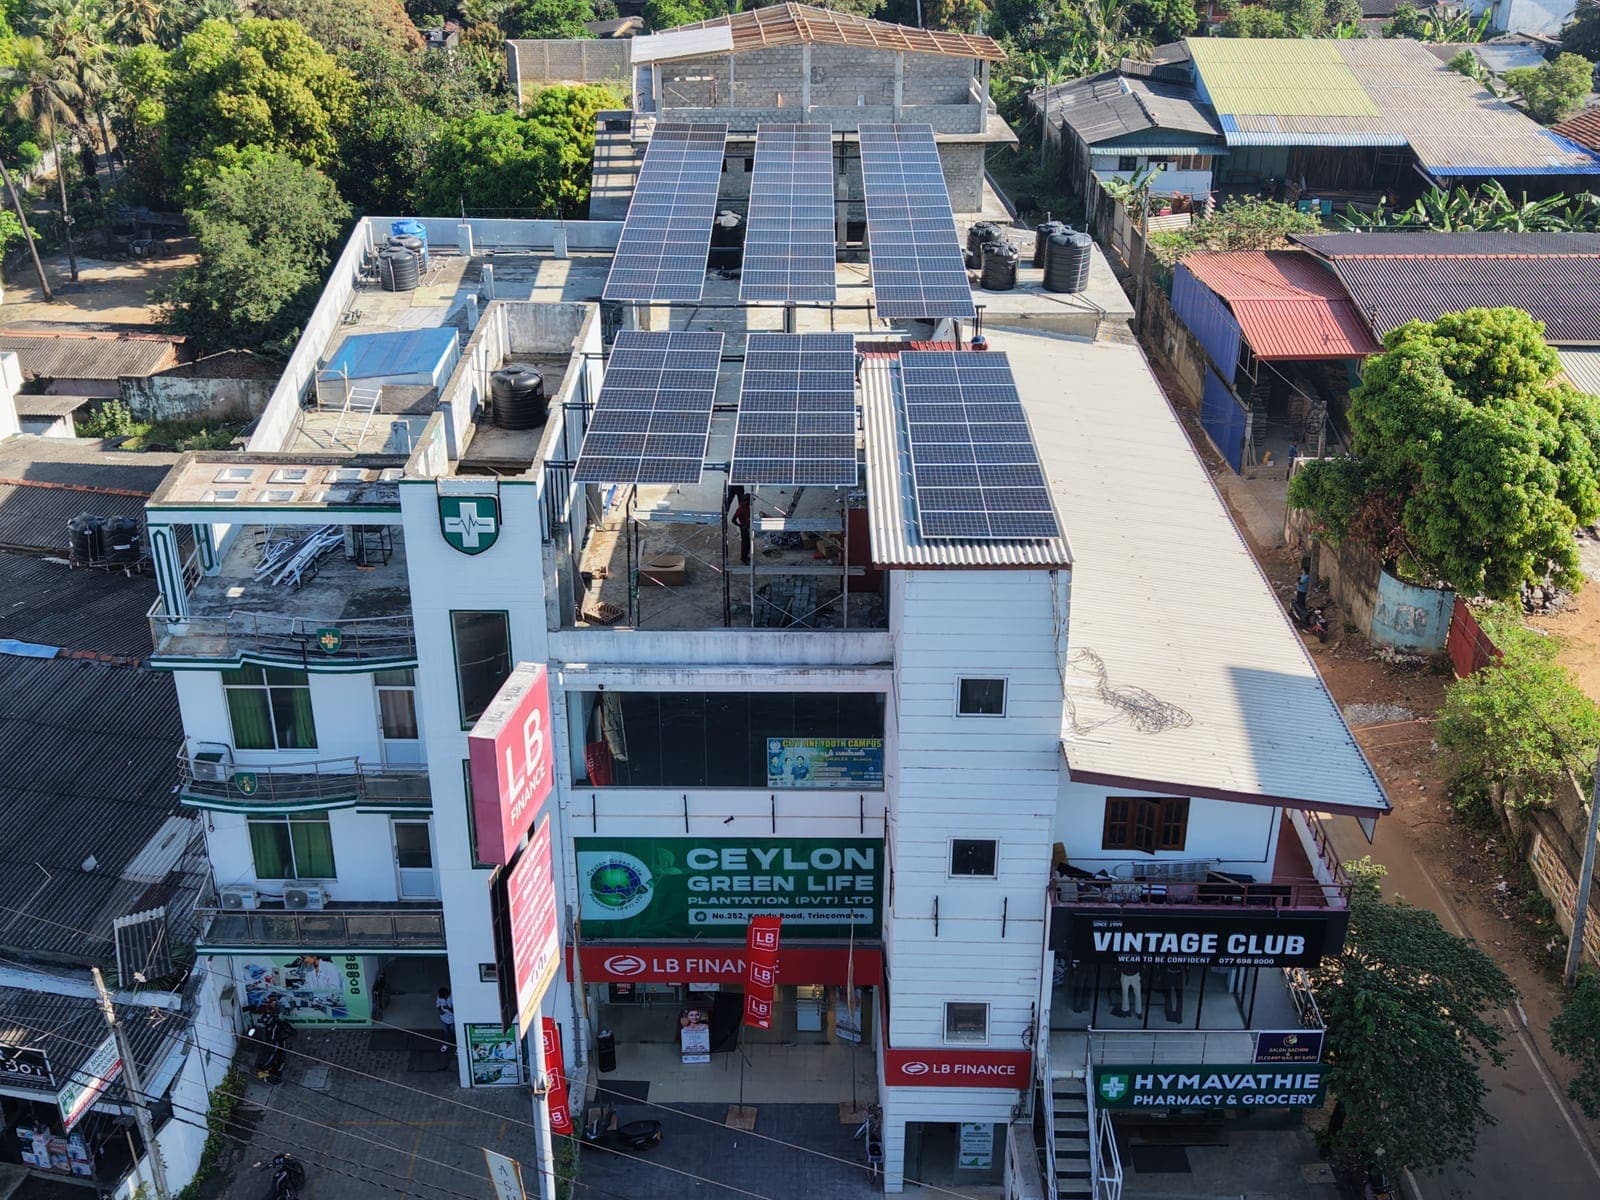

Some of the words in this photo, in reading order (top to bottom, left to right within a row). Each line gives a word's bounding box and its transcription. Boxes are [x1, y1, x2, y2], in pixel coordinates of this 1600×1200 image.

[847, 739, 882, 748] CAMPUS
[505, 708, 544, 805] LB
[511, 759, 546, 827] FINANCE
[686, 847, 875, 870] CEYLON
[687, 875, 795, 892] GREEN
[807, 875, 874, 891] LIFE
[688, 896, 790, 905] PLANTATION
[795, 895, 839, 905] (PVT)
[847, 896, 874, 905] LTD
[807, 912, 867, 920] Trincomaee.
[757, 932, 774, 944] LB
[1093, 931, 1218, 954] VINTAGE
[1227, 934, 1306, 955] CLUB
[653, 959, 679, 973] LB
[754, 967, 771, 980] LB
[752, 1000, 768, 1013] LB
[933, 1064, 950, 1074] LB
[954, 1064, 1016, 1075] FINANCE
[1134, 1073, 1321, 1090] HYMAVATHIE
[1133, 1095, 1222, 1106] PHARMACY
[1226, 1095, 1238, 1105] &
[1242, 1094, 1318, 1105] GROCERY
